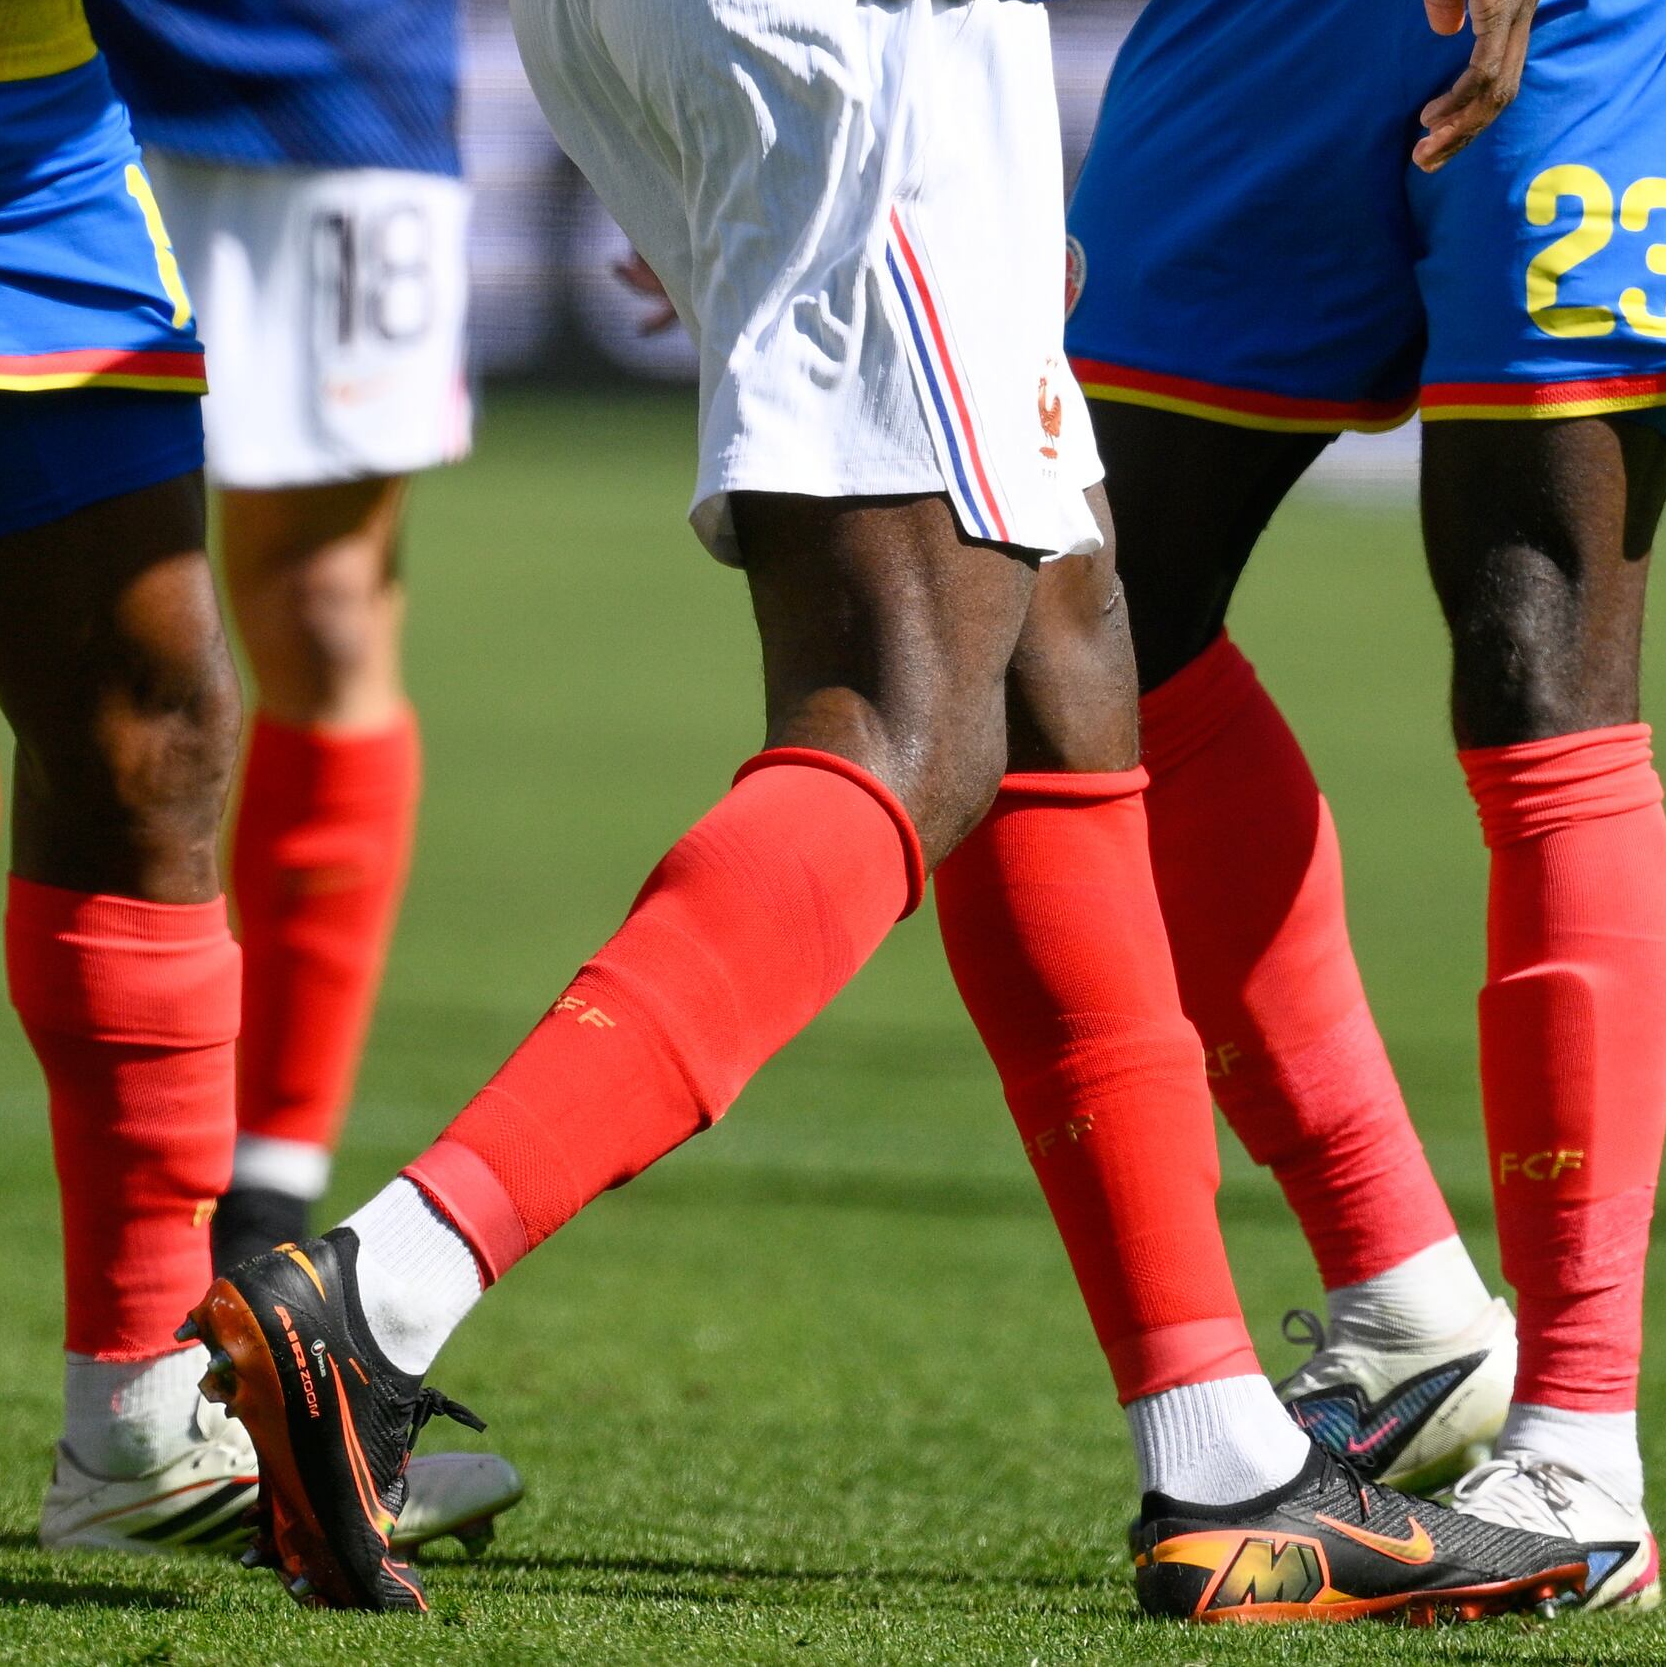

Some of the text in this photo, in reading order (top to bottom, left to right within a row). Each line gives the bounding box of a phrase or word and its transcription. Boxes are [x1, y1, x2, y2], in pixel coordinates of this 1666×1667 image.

[306, 200, 433, 347] 18
[1499, 1149, 1585, 1185] FCF
[273, 1304, 321, 1419] AIR ZOOM
